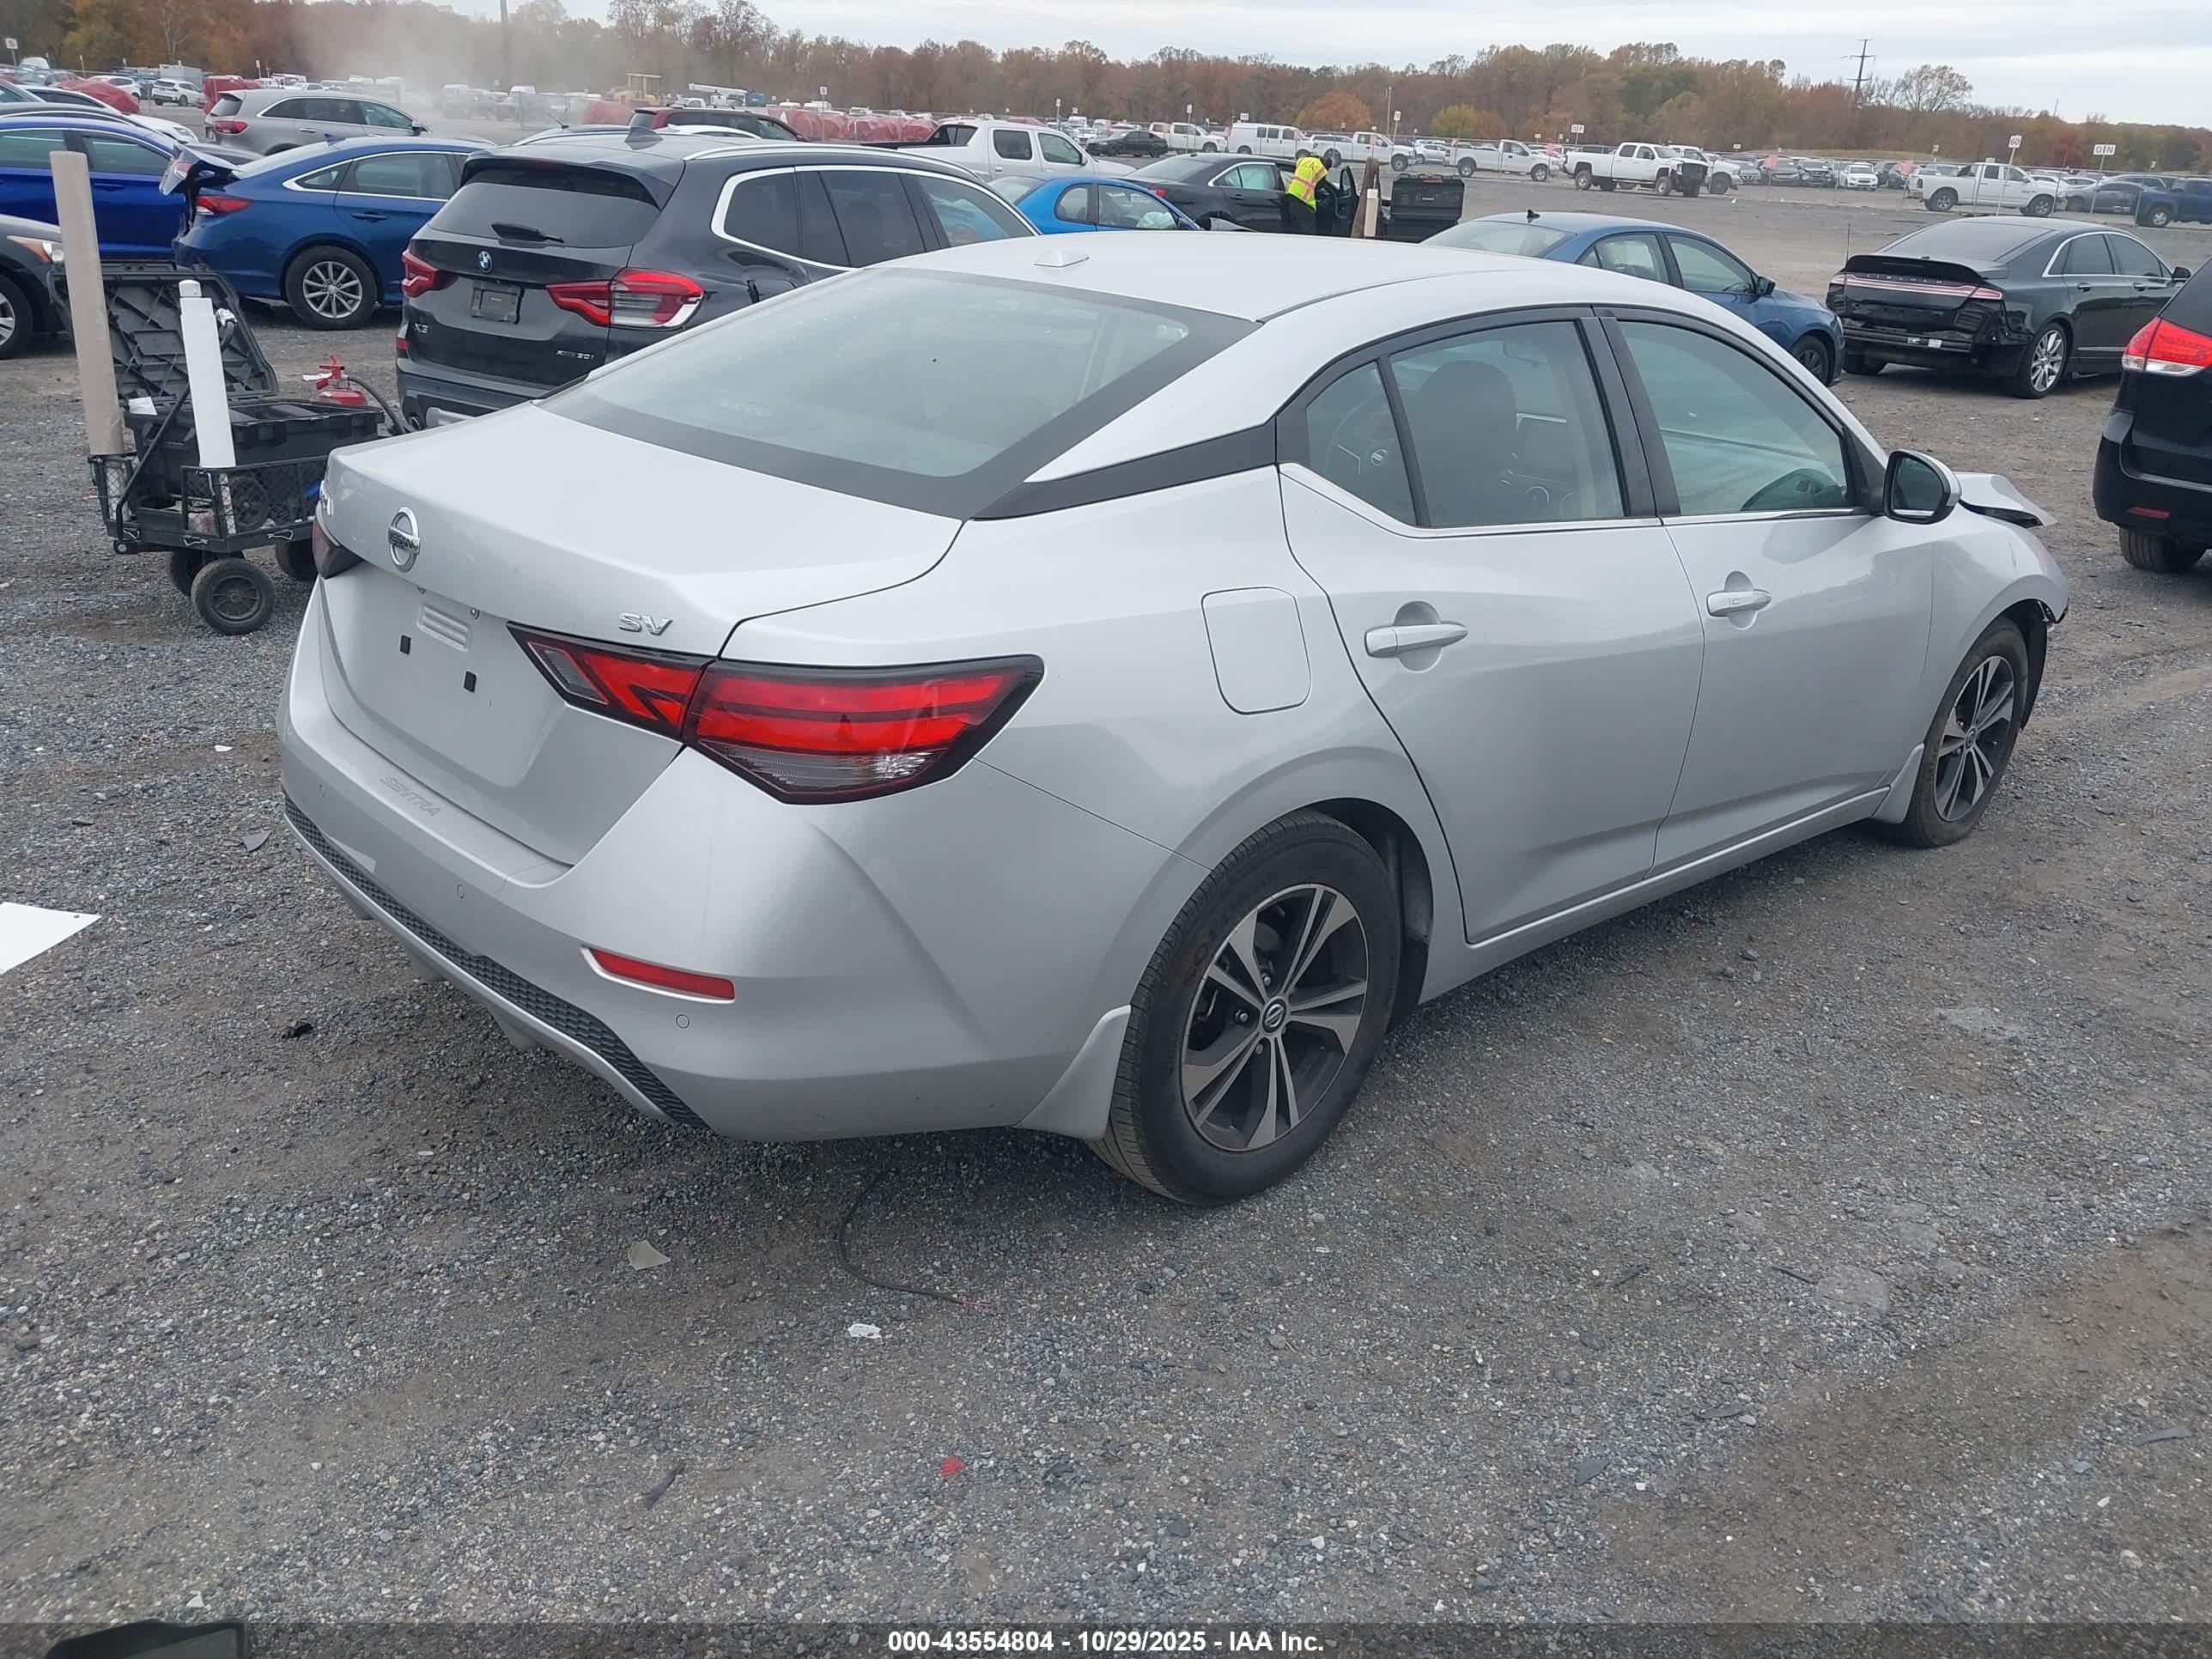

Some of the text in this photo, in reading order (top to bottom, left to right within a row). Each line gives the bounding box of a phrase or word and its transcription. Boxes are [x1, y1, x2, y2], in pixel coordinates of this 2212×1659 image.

[414, 323, 428, 334] X3
[618, 612, 673, 635] SV
[380, 777, 441, 817] SENTRA
